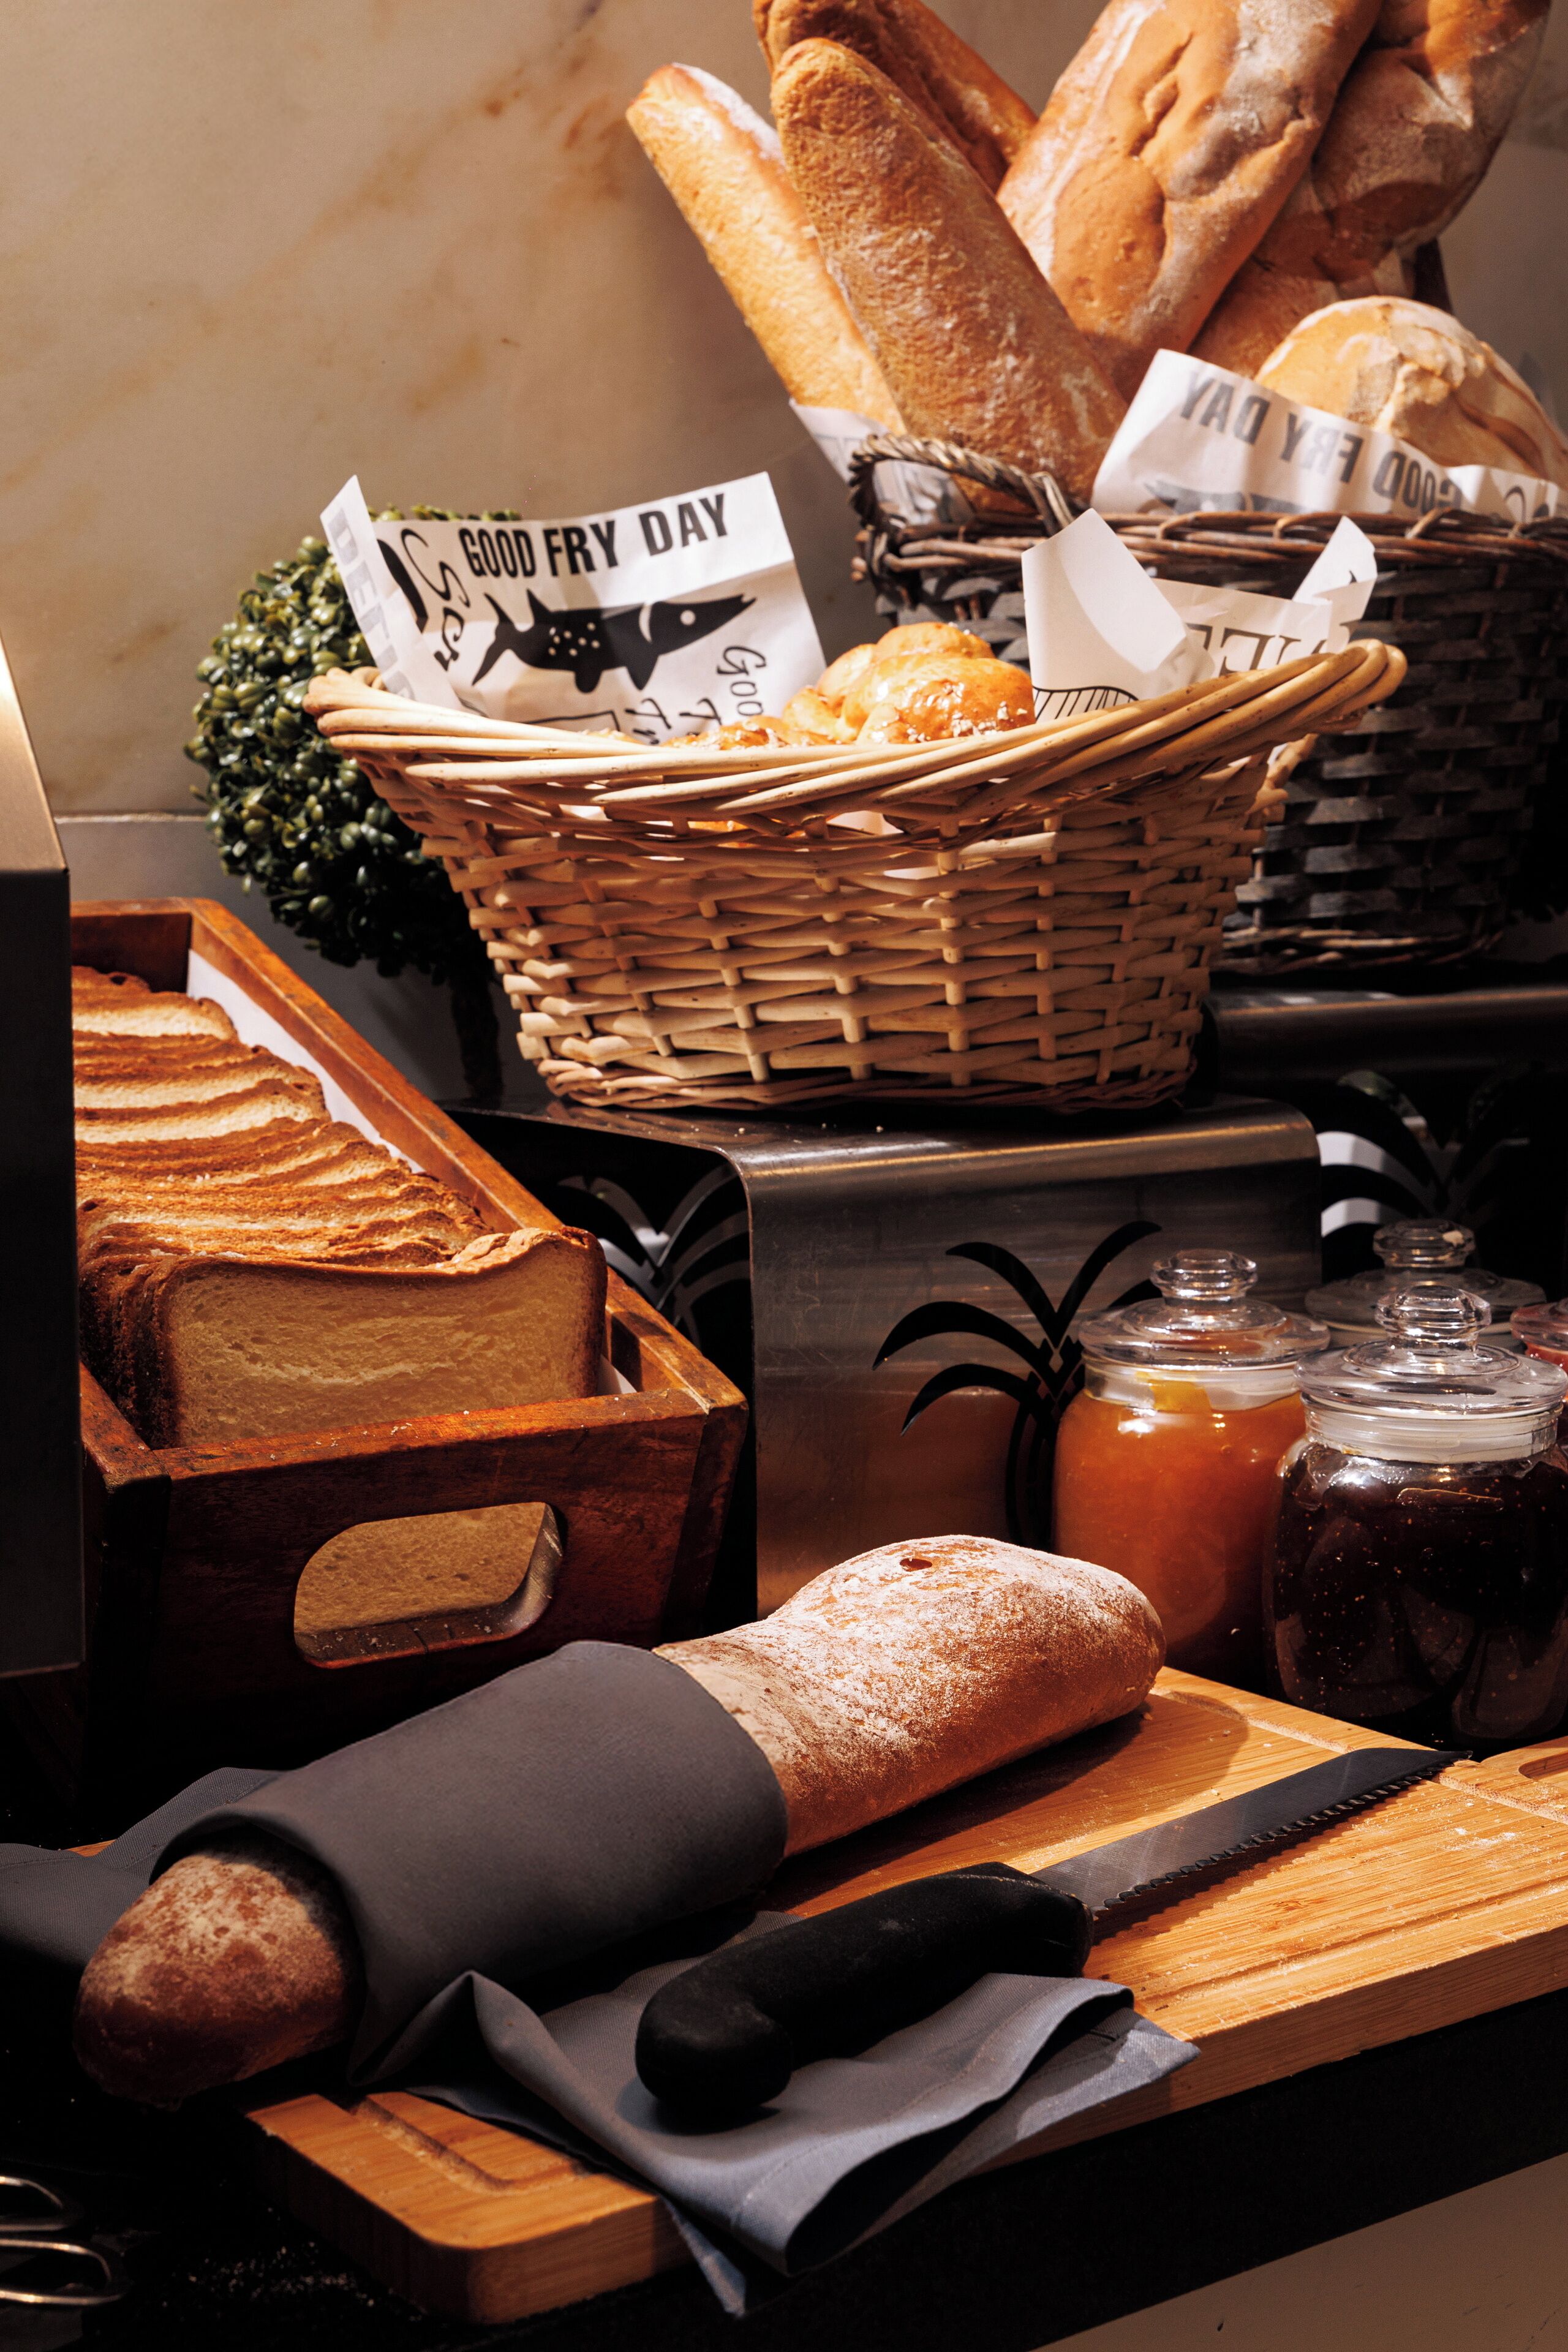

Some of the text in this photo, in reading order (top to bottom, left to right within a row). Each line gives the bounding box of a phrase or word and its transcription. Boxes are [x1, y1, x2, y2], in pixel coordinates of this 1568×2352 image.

[459, 492, 729, 578] GOOD FRY DAY
[716, 645, 767, 717] Goo
